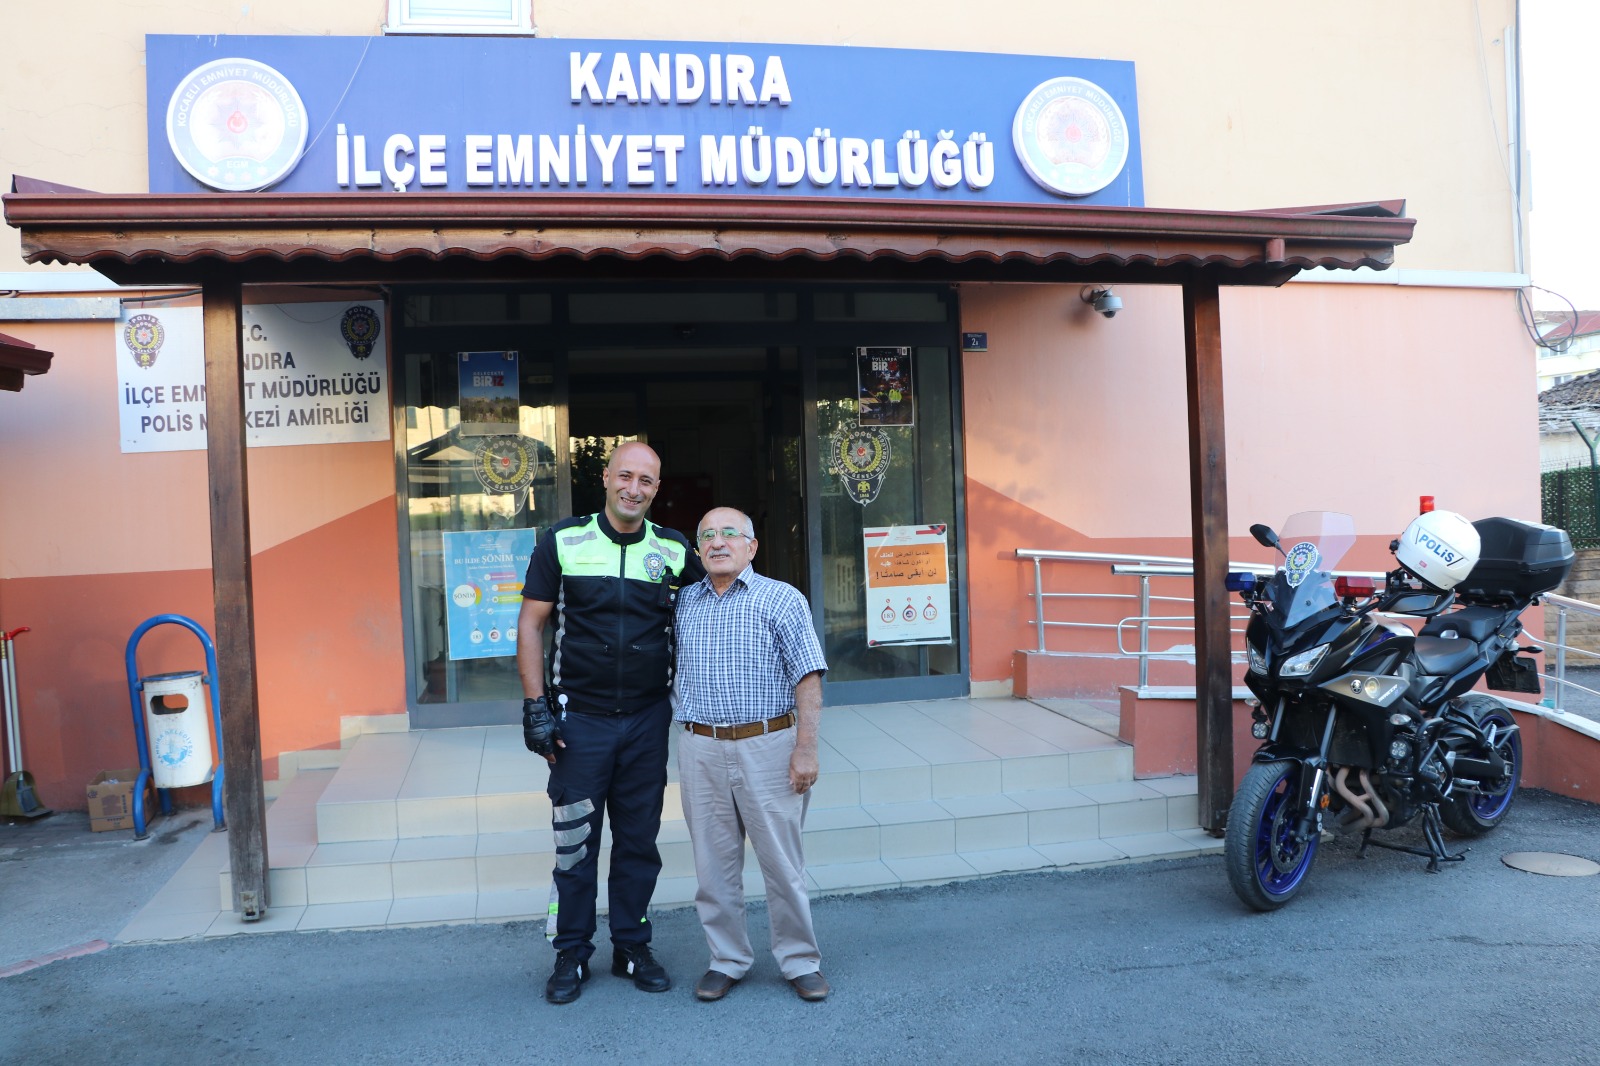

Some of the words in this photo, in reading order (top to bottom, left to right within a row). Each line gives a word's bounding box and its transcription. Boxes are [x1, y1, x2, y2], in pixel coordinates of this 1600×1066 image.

[201, 67, 249, 86] EMNİYET
[570, 51, 792, 106] KANDIRA
[336, 123, 448, 192] İLÇE
[466, 123, 685, 187] EMNİYET
[700, 125, 994, 191] MÜDÜRLÜĞÜ
[243, 324, 267, 341] .C.
[243, 352, 296, 370] NDIRA
[125, 382, 165, 408] İLÇE
[262, 371, 381, 399] MÜDÜRLÜĞÜ
[141, 409, 193, 433] POLİS
[286, 400, 369, 427] AMİRLİĞİ
